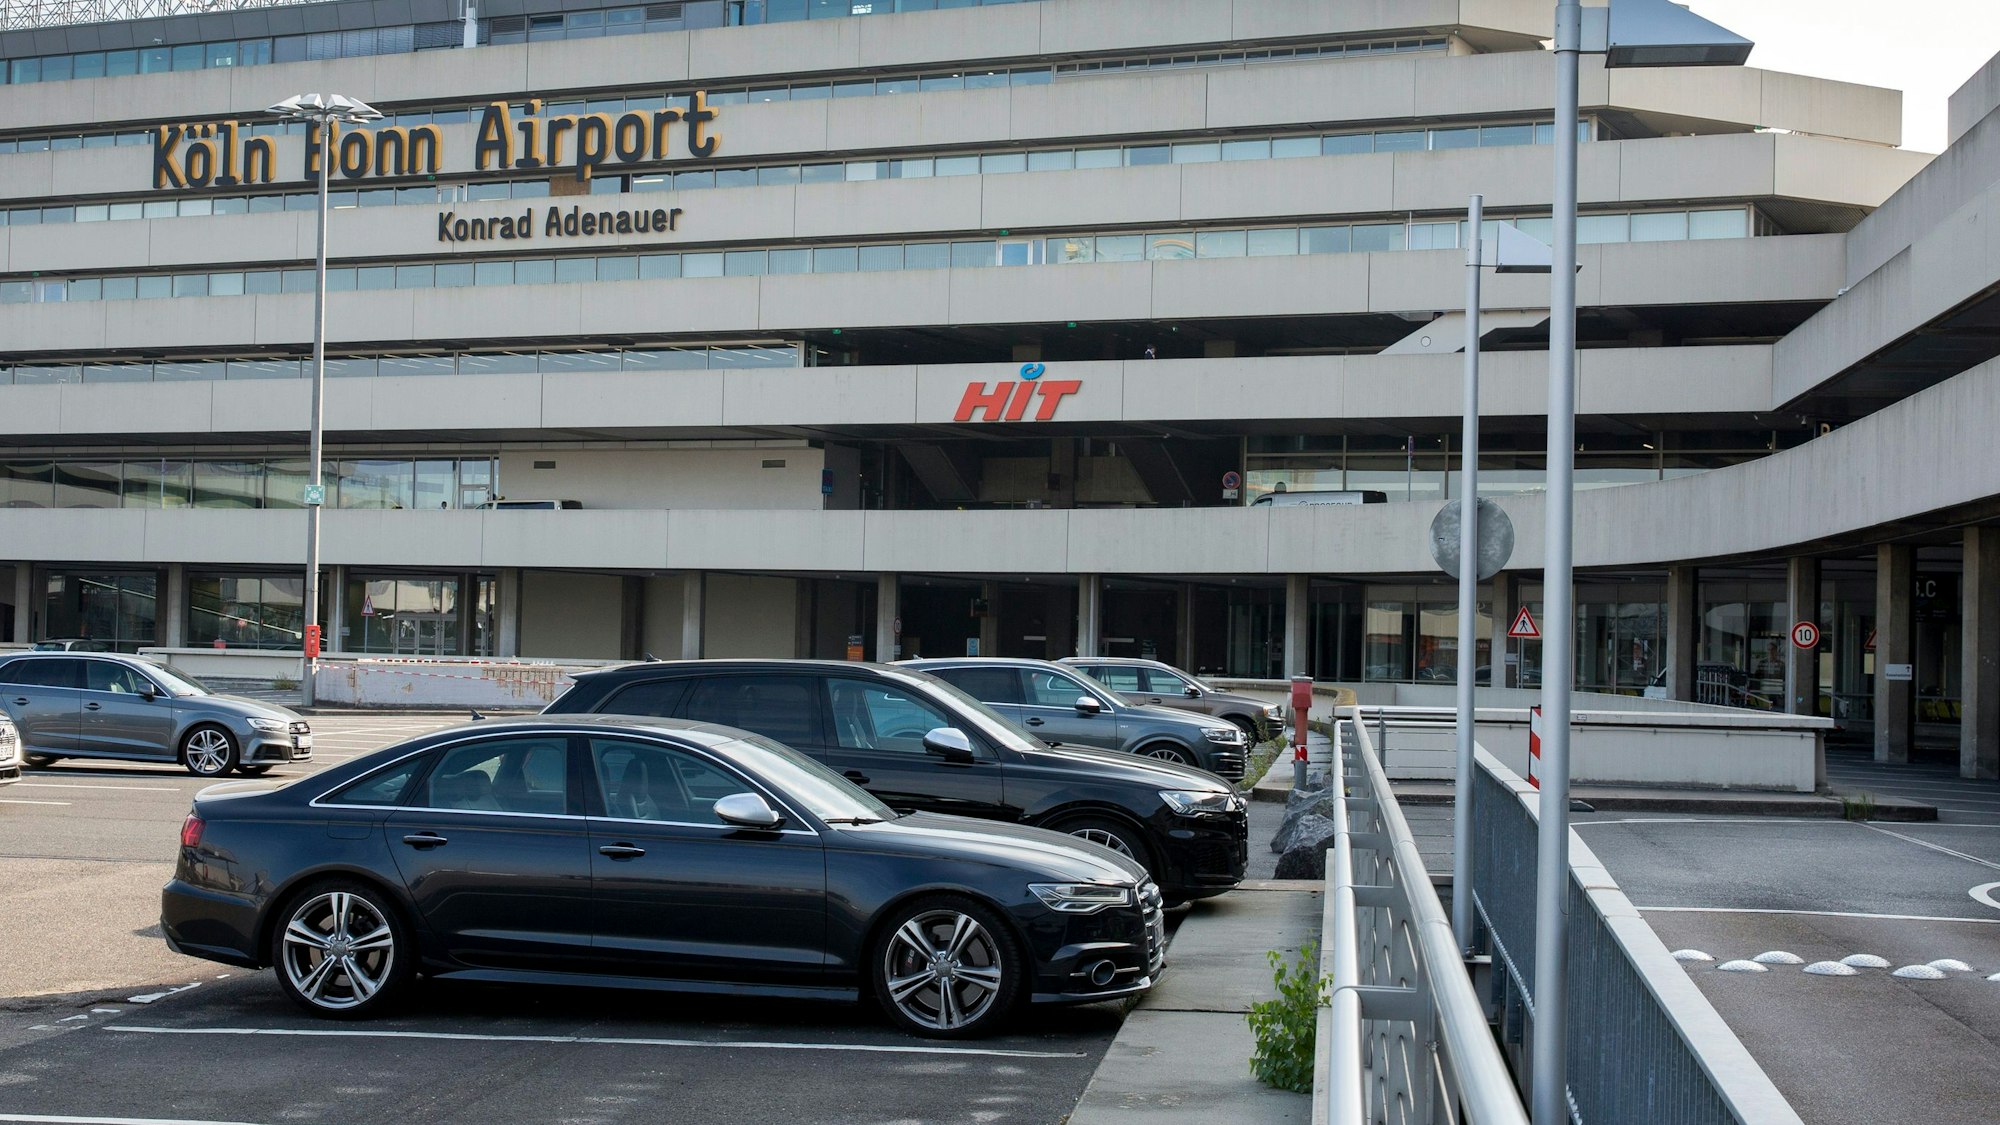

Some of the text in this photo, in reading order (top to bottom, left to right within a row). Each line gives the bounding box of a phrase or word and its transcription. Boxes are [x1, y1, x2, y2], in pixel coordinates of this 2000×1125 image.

[153, 90, 722, 189] Köln Bonn Airport
[438, 205, 682, 242] Konrad Adenauer
[1798, 629, 1812, 641] 10
